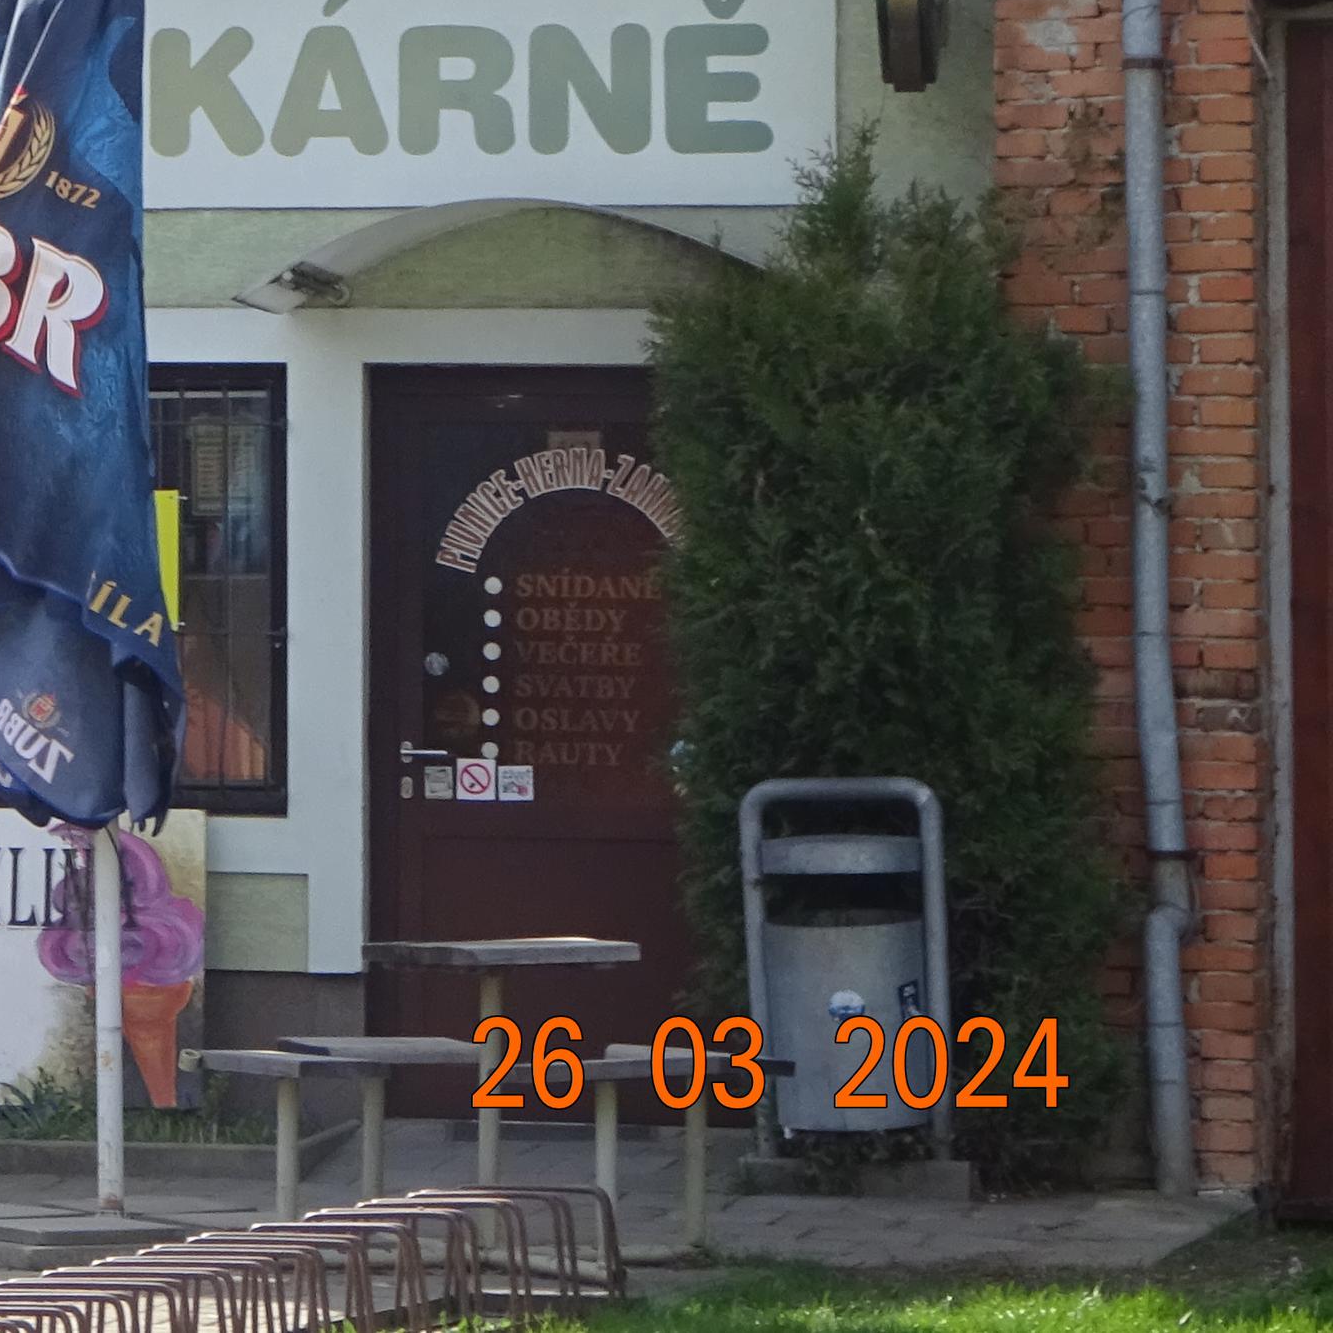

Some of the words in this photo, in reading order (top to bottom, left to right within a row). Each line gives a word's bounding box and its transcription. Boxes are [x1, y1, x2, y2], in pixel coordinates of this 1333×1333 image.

[45, 170, 102, 210] 1872
[516, 602, 628, 632] OBĚDY
[514, 675, 636, 699] SVATBY
[514, 707, 640, 733] OSLAVY
[514, 741, 623, 766] RAUTY
